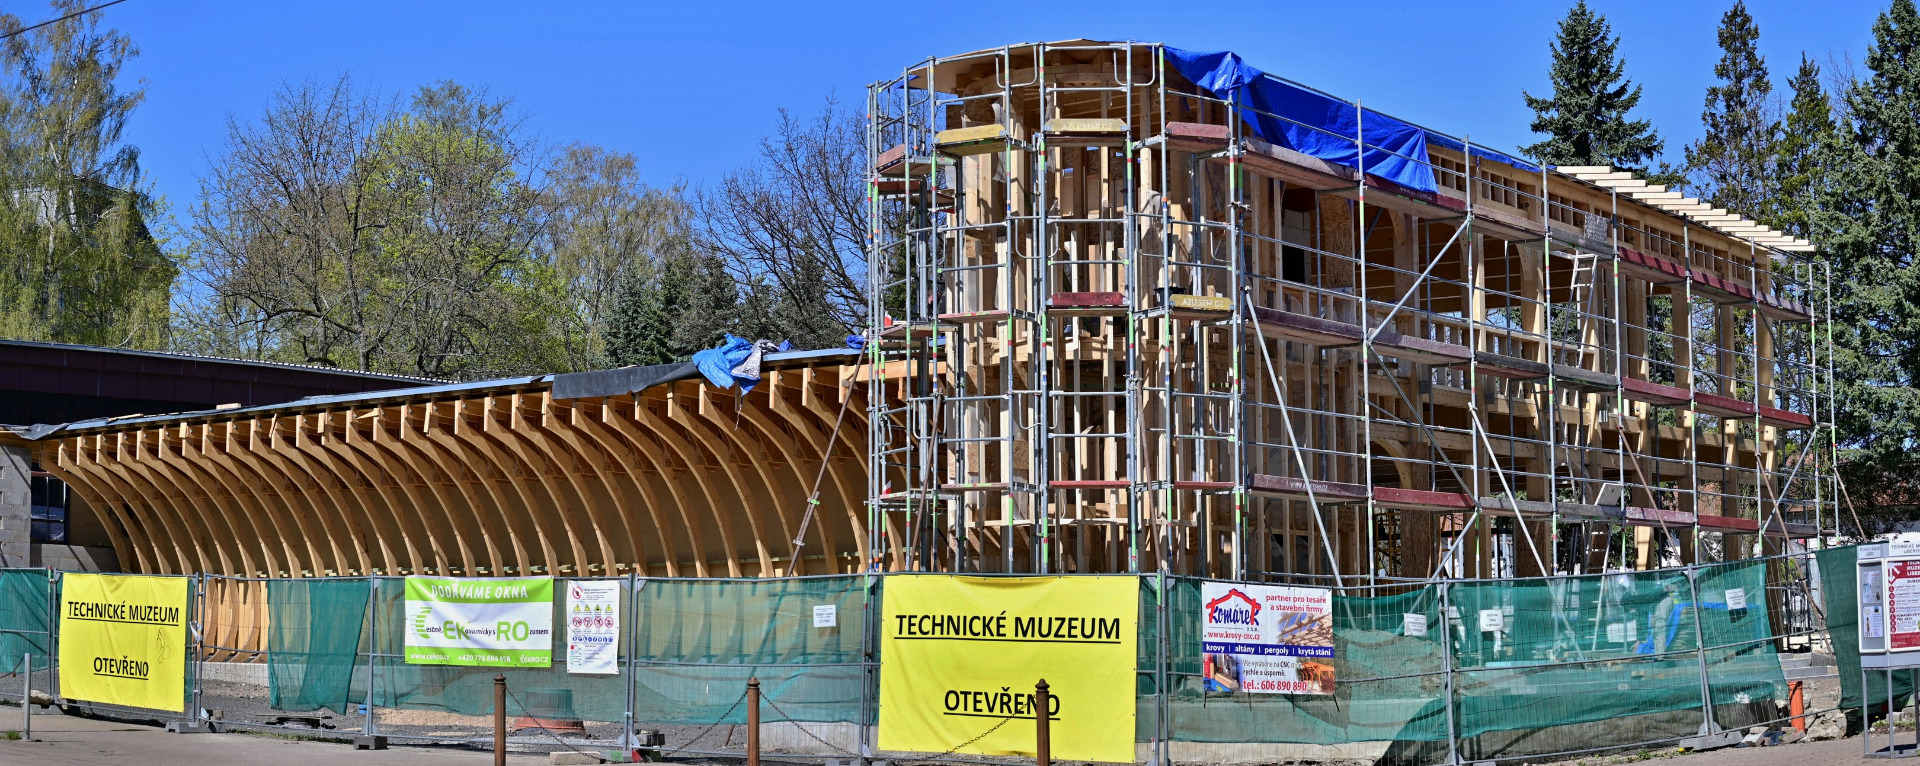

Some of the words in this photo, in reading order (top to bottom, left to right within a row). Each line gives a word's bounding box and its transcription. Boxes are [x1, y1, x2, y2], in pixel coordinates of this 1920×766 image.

[495, 585, 528, 599] OKNA
[68, 600, 125, 620] TECHNICKÉ
[129, 605, 179, 623] MUZEUM
[1306, 605, 1324, 614] firmy
[895, 610, 1007, 638] TECHNICKÉ
[1014, 616, 1120, 640] MUZEUM
[1207, 631, 1261, 641] www.krovy-cnc.cz
[1206, 643, 1225, 653] krovy
[1235, 645, 1255, 654] altány
[1264, 647, 1289, 656] pergoly
[1298, 649, 1315, 657] krytá
[410, 653, 450, 661] www.cekro.cz
[457, 654, 474, 662] +420
[474, 654, 486, 662] 776
[486, 654, 499, 662] 694
[499, 655, 511, 663] 458
[1280, 660, 1290, 668] CNC
[93, 655, 149, 677] OTEVŘENO
[1243, 668, 1259, 676] rychle
[1243, 679, 1260, 690] tel.:
[1260, 680, 1276, 691] 606
[1276, 680, 1292, 691] 890
[1292, 681, 1307, 692] 890
[944, 687, 1060, 716] OTEVŘENO
